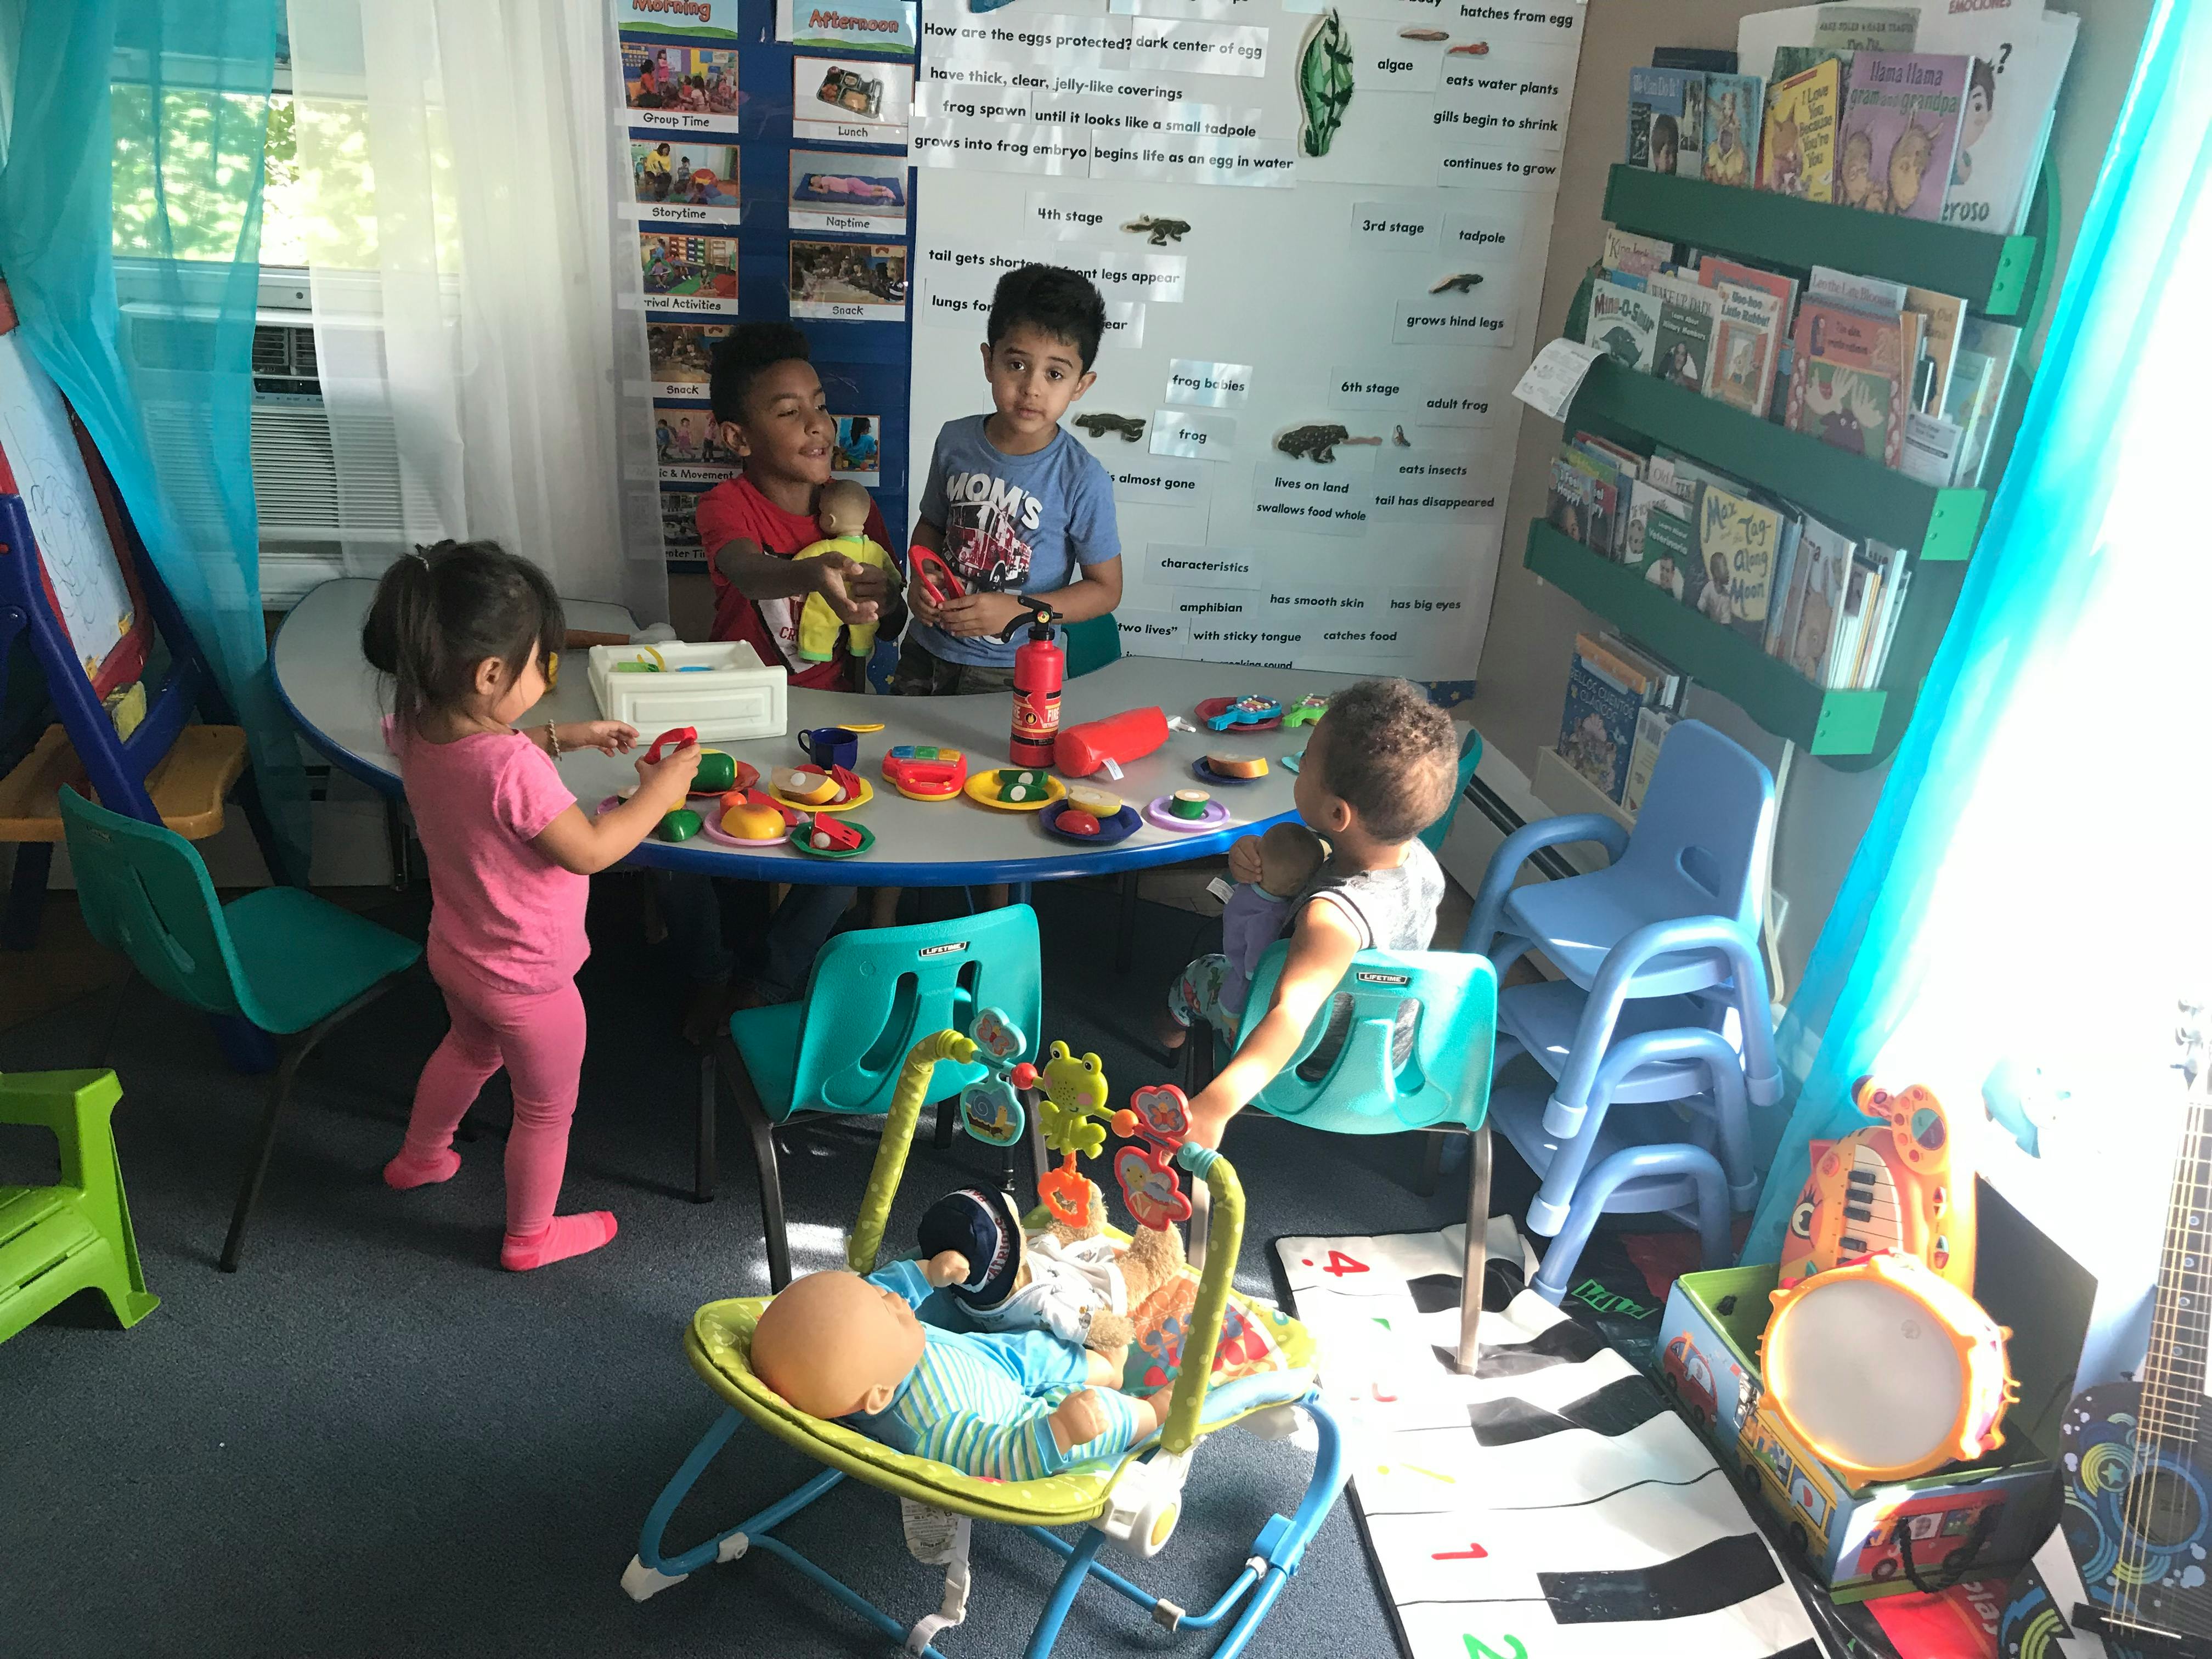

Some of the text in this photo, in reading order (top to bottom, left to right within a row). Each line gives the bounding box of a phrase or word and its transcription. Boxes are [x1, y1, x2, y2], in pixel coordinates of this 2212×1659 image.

[633, 0, 711, 22] Morning
[1460, 5, 1573, 28] hatches from egg
[809, 9, 899, 33] Afternoon
[925, 23, 1262, 59] How are the eggs protected? dark center of egg
[1378, 59, 1413, 73] algae
[931, 67, 1182, 101] have thick, clear, jelly-like coverings
[1447, 76, 1558, 95] eats water plants
[1850, 88, 1880, 109] gram
[1900, 91, 1960, 117] grandpa
[644, 112, 709, 127] Group Time
[943, 100, 974, 116] frog
[980, 106, 1025, 117] spawn
[1036, 111, 1065, 122] until
[1070, 112, 1080, 123] it
[1085, 113, 1120, 126] looks
[1126, 116, 1148, 128] like
[1166, 121, 1200, 132] small
[1205, 124, 1255, 137] tadpole
[1434, 111, 1558, 131] gills begin to shrink
[839, 126, 868, 137] Lunch
[915, 137, 960, 149] grows
[965, 138, 992, 150] into
[997, 140, 1028, 156] frog
[1033, 144, 1087, 159] embryo
[1095, 147, 1138, 162] begins
[1143, 150, 1164, 162] life
[1209, 157, 1233, 168] egg
[1238, 155, 1249, 166] in
[1254, 159, 1293, 168] water
[1444, 158, 1556, 176] continues to grow
[652, 207, 706, 219] Storytime
[1039, 208, 1102, 225] 4th stage
[827, 217, 870, 229] Naptime
[1363, 220, 1424, 236] 3rd stage
[1459, 230, 1505, 244] tadpole
[929, 250, 951, 261] tail
[956, 255, 984, 266] gets
[1102, 269, 1127, 283] legs
[1132, 273, 1179, 285] appear
[673, 298, 721, 310] Activities
[833, 306, 864, 315] Snack
[933, 295, 967, 311] lungs
[1407, 315, 1503, 330] grows hind legs
[667, 385, 698, 394] Snack
[1172, 375, 1244, 391] frog babies
[1341, 382, 1399, 396] 6th stage
[1427, 398, 1488, 413] adult frog
[1180, 429, 1206, 444] frog
[670, 469, 678, 477] &
[681, 469, 733, 479] Movement
[1400, 465, 1466, 475] eats insects
[1119, 473, 1195, 489] almost gone
[1275, 477, 1301, 488] lives
[1323, 482, 1349, 493] land
[947, 472, 1042, 530] MOM'S
[1375, 496, 1494, 509] tail has disappeared
[1257, 504, 1365, 520] swallows food whole
[665, 549, 690, 557] enter
[1161, 558, 1248, 572] characteristics
[1180, 603, 1242, 614] amphibian
[1270, 594, 1364, 608] has smooth skin
[1391, 600, 1461, 611] has big eyes
[1194, 631, 1301, 644] with sticky tongue
[1324, 631, 1397, 641] catches food
[1047, 707, 1059, 723] FIRE
[927, 943, 961, 954] LIFETIME
[1364, 974, 1401, 982] LIFETIME
[1323, 1250, 1370, 1277] 4
[1431, 1542, 1488, 1560] 1
